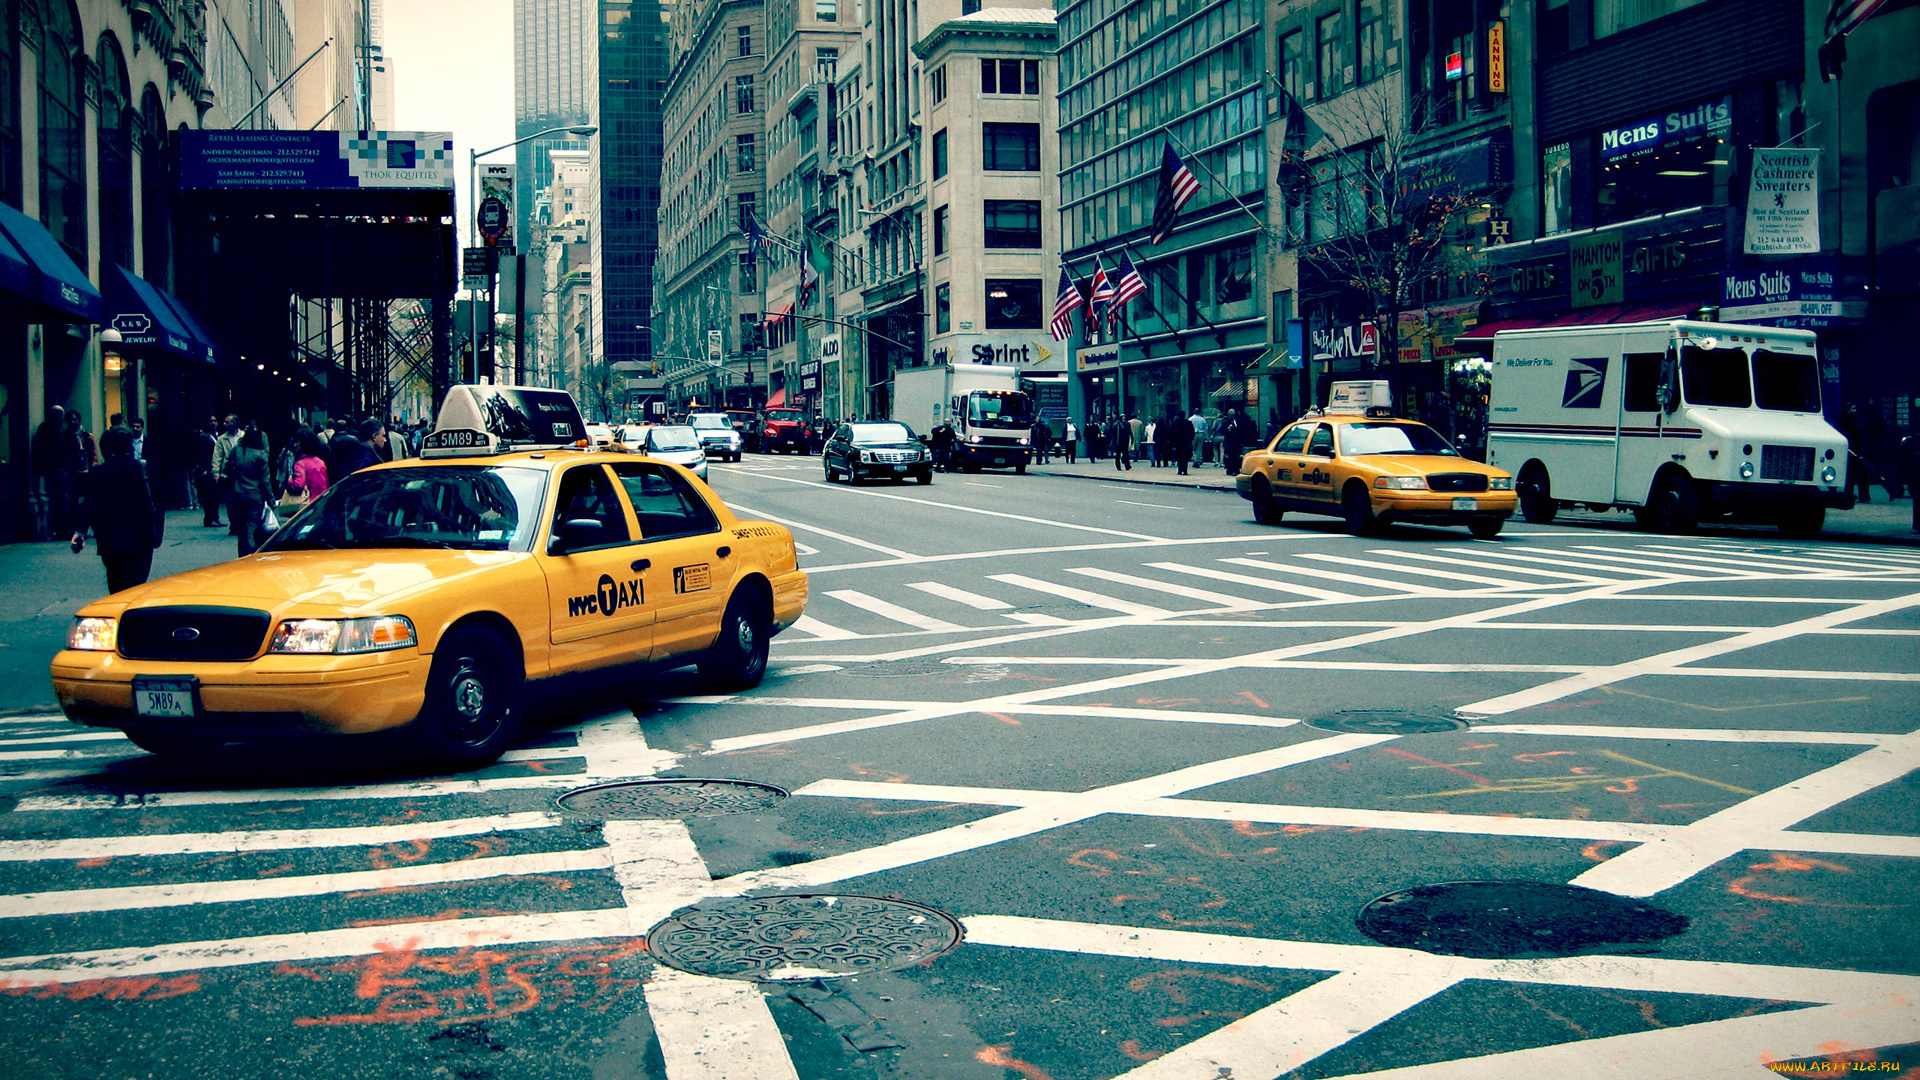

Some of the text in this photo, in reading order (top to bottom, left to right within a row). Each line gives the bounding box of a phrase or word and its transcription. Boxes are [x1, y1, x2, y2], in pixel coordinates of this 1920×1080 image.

[1492, 29, 1501, 88] TANNING
[1602, 103, 1728, 151] Mens Suits
[1707, 128, 1727, 138] DKNY
[1760, 154, 1810, 166] Scottish
[364, 171, 438, 180] THOR EQUITIES
[1754, 167, 1815, 179] Cashmere
[1754, 180, 1811, 192] Sweaters
[1572, 241, 1621, 269] PHANTOM
[1632, 241, 1686, 274] GIFTS
[1511, 263, 1555, 293] GIFTS
[1801, 271, 1816, 283] Mens
[1817, 271, 1833, 284] Suits
[1578, 278, 1590, 292] ON
[1726, 270, 1791, 300] Mens Suits
[1820, 303, 1833, 314] OFF
[1810, 318, 1829, 327] floor
[823, 339, 839, 357] ALDO
[1506, 359, 1515, 367] We
[1515, 358, 1532, 367] Deliver
[1533, 358, 1542, 366] For
[441, 432, 472, 446] 5M89
[568, 576, 645, 617] NYC TAXI
